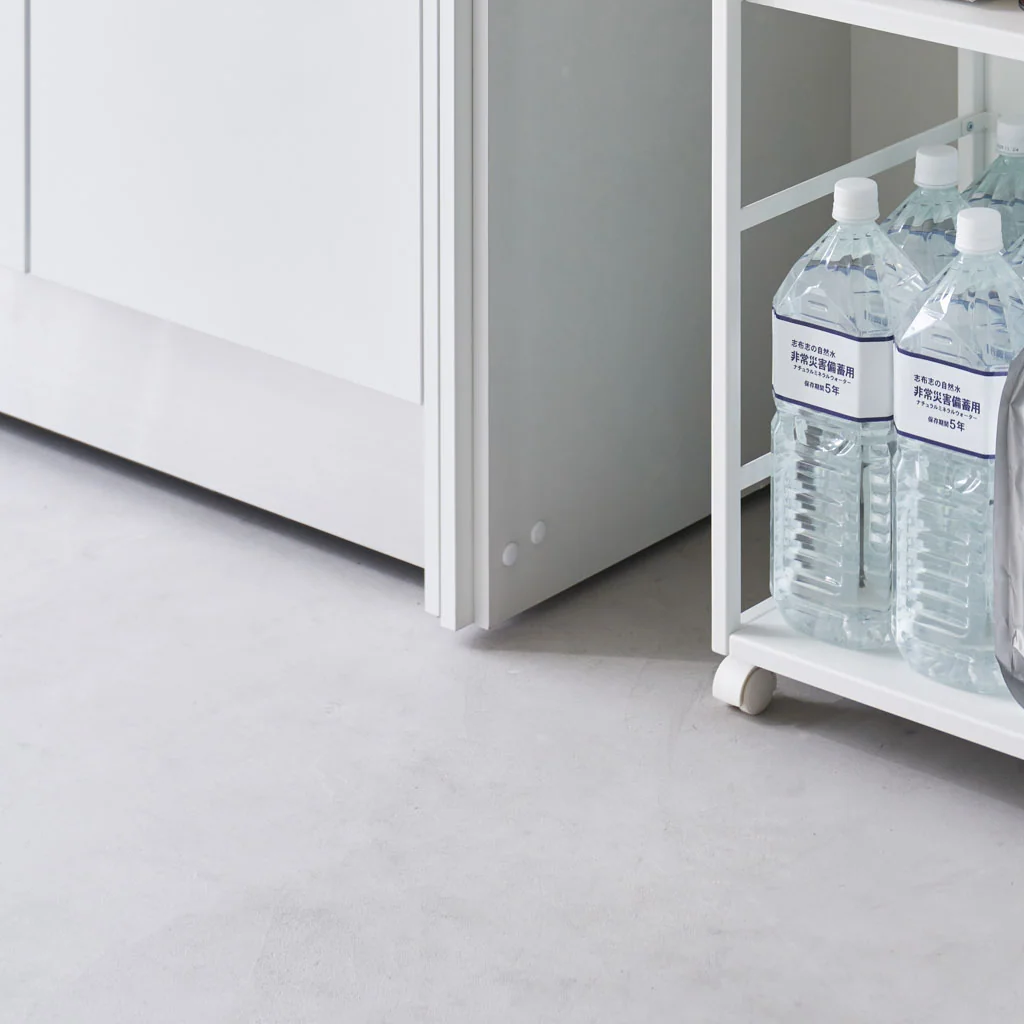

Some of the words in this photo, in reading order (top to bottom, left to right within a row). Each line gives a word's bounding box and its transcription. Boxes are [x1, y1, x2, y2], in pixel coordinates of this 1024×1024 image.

[791, 339, 836, 359] 志布志の自然水
[790, 350, 855, 379] 非常災害備蓄用
[793, 364, 852, 385] ナチュラルミネラルウォーター
[913, 374, 961, 394] 志布志の自然水
[913, 385, 981, 415] 非常災害備蓄用
[916, 399, 978, 420] ナチュラルミネラルウォーター
